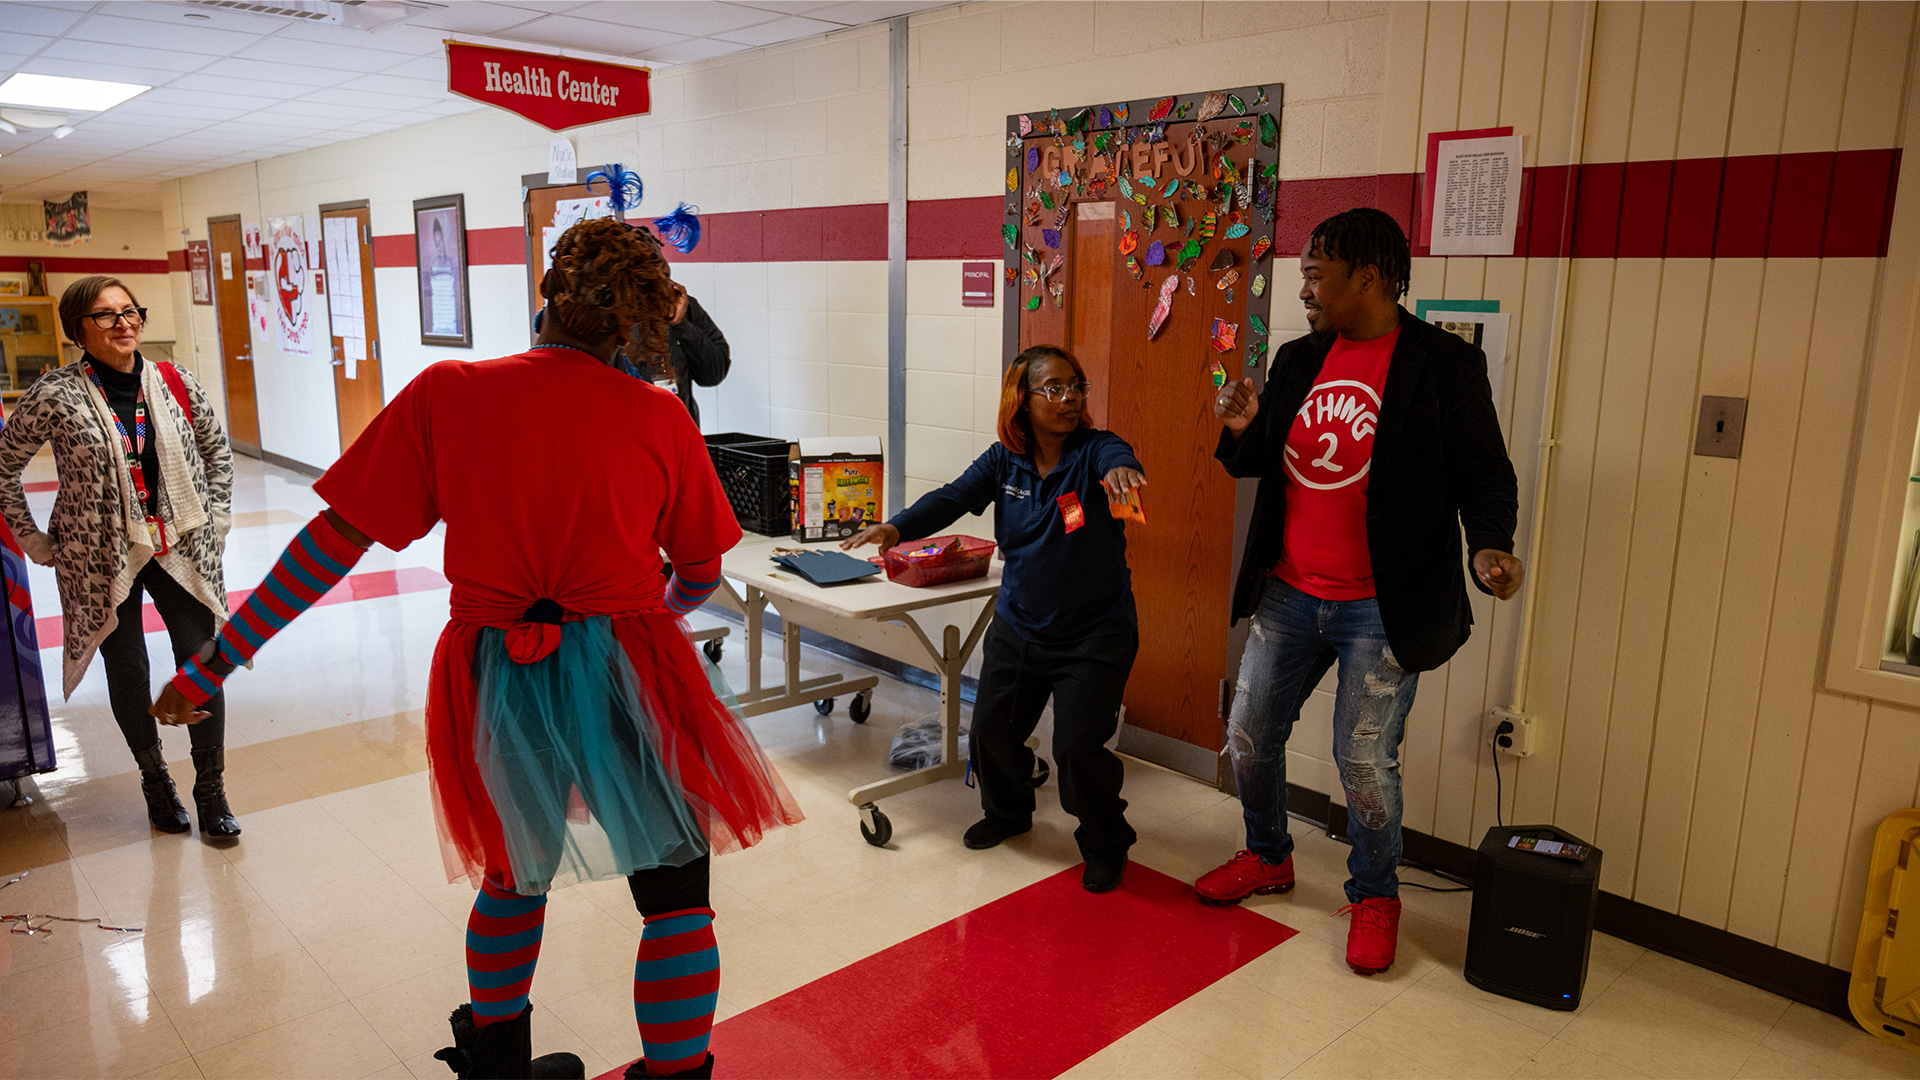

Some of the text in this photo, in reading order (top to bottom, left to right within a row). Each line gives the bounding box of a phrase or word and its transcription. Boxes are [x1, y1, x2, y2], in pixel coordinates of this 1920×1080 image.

[483, 61, 619, 106] Health Center
[964, 271, 990, 279] PRINCIPAL
[1296, 393, 1378, 441] THING
[1311, 432, 1343, 472] 2
[837, 476, 869, 487] HALLOWEEN
[1064, 504, 1077, 514] STAY
[1508, 926, 1541, 939] BOSE
